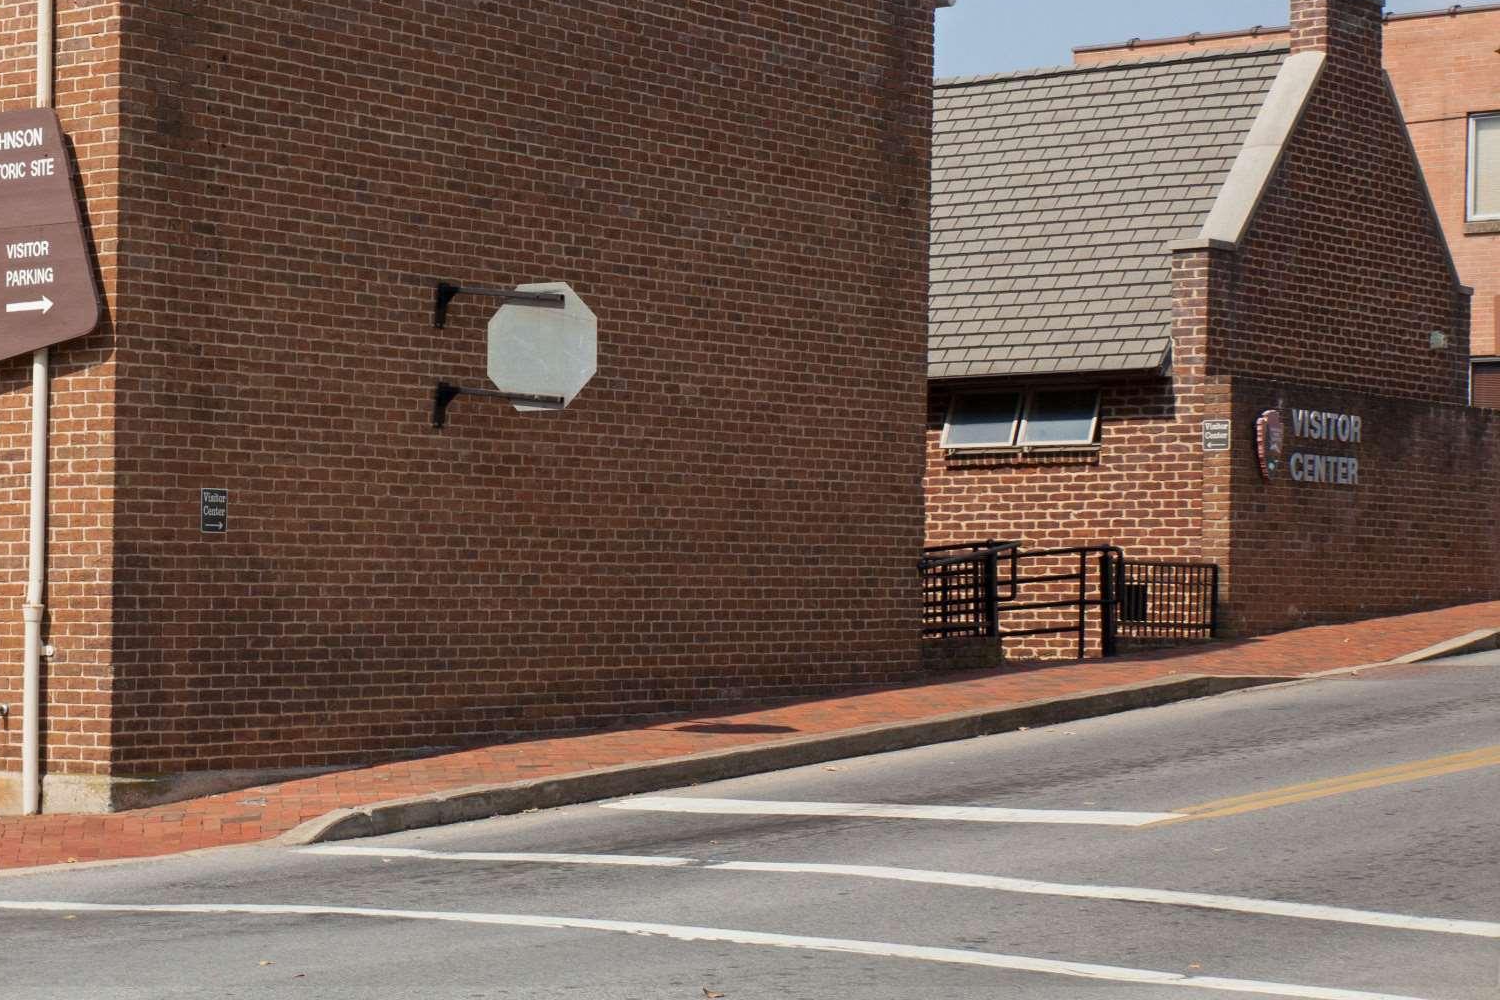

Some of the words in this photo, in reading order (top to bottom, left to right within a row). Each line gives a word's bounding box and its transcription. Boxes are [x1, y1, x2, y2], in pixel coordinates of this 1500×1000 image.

[30, 158, 54, 177] SITE
[6, 240, 49, 259] VISITOR
[6, 268, 54, 287] PARKING
[1205, 422, 1229, 431] Visitor
[1292, 409, 1362, 443] VISITOR
[1204, 432, 1228, 440] Center
[1290, 453, 1358, 484] CENTER
[203, 505, 226, 517] Center
